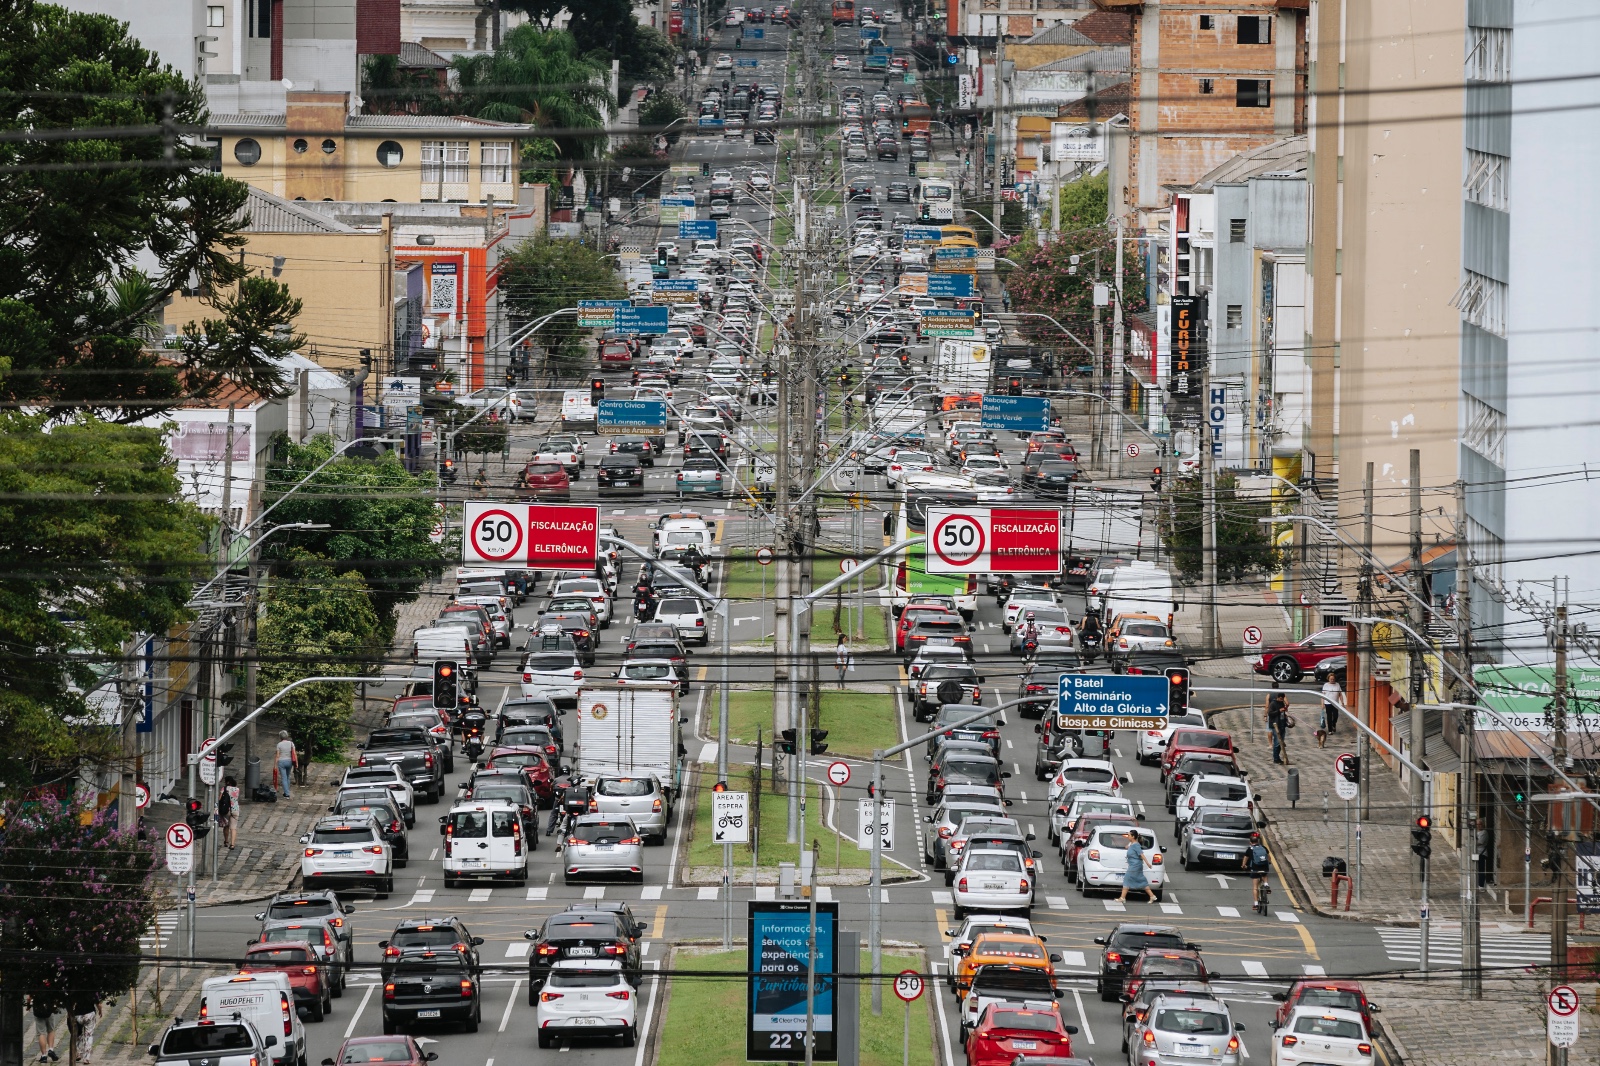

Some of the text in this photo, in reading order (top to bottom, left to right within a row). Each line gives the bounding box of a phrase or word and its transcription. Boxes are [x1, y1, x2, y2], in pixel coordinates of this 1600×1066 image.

[1178, 310, 1189, 369] FURUTA
[983, 412, 1000, 420] Água
[1210, 389, 1225, 458] HOTE
[481, 520, 512, 542] 50
[531, 521, 594, 533] FISCALIZAÇÃO
[993, 523, 1056, 534] FISCALIZAÇÃO
[944, 525, 975, 546] 50
[487, 546, 505, 554] km/h
[535, 543, 588, 554] ELETRÔNICA
[997, 545, 1051, 556] ELETRÔNICA
[1074, 678, 1104, 688] Batel
[1074, 690, 1132, 701] Seminário
[1073, 702, 1152, 714] Alto da Glória
[1109, 717, 1155, 728] Clínicas
[761, 924, 826, 934] Informações,
[761, 937, 802, 948] serviços
[761, 950, 824, 961] experiêncas
[761, 964, 785, 973] para
[758, 976, 827, 993] Curitibaos
[899, 977, 919, 990] 50
[220, 997, 238, 1006] HUGO
[769, 1033, 792, 1048] 22
